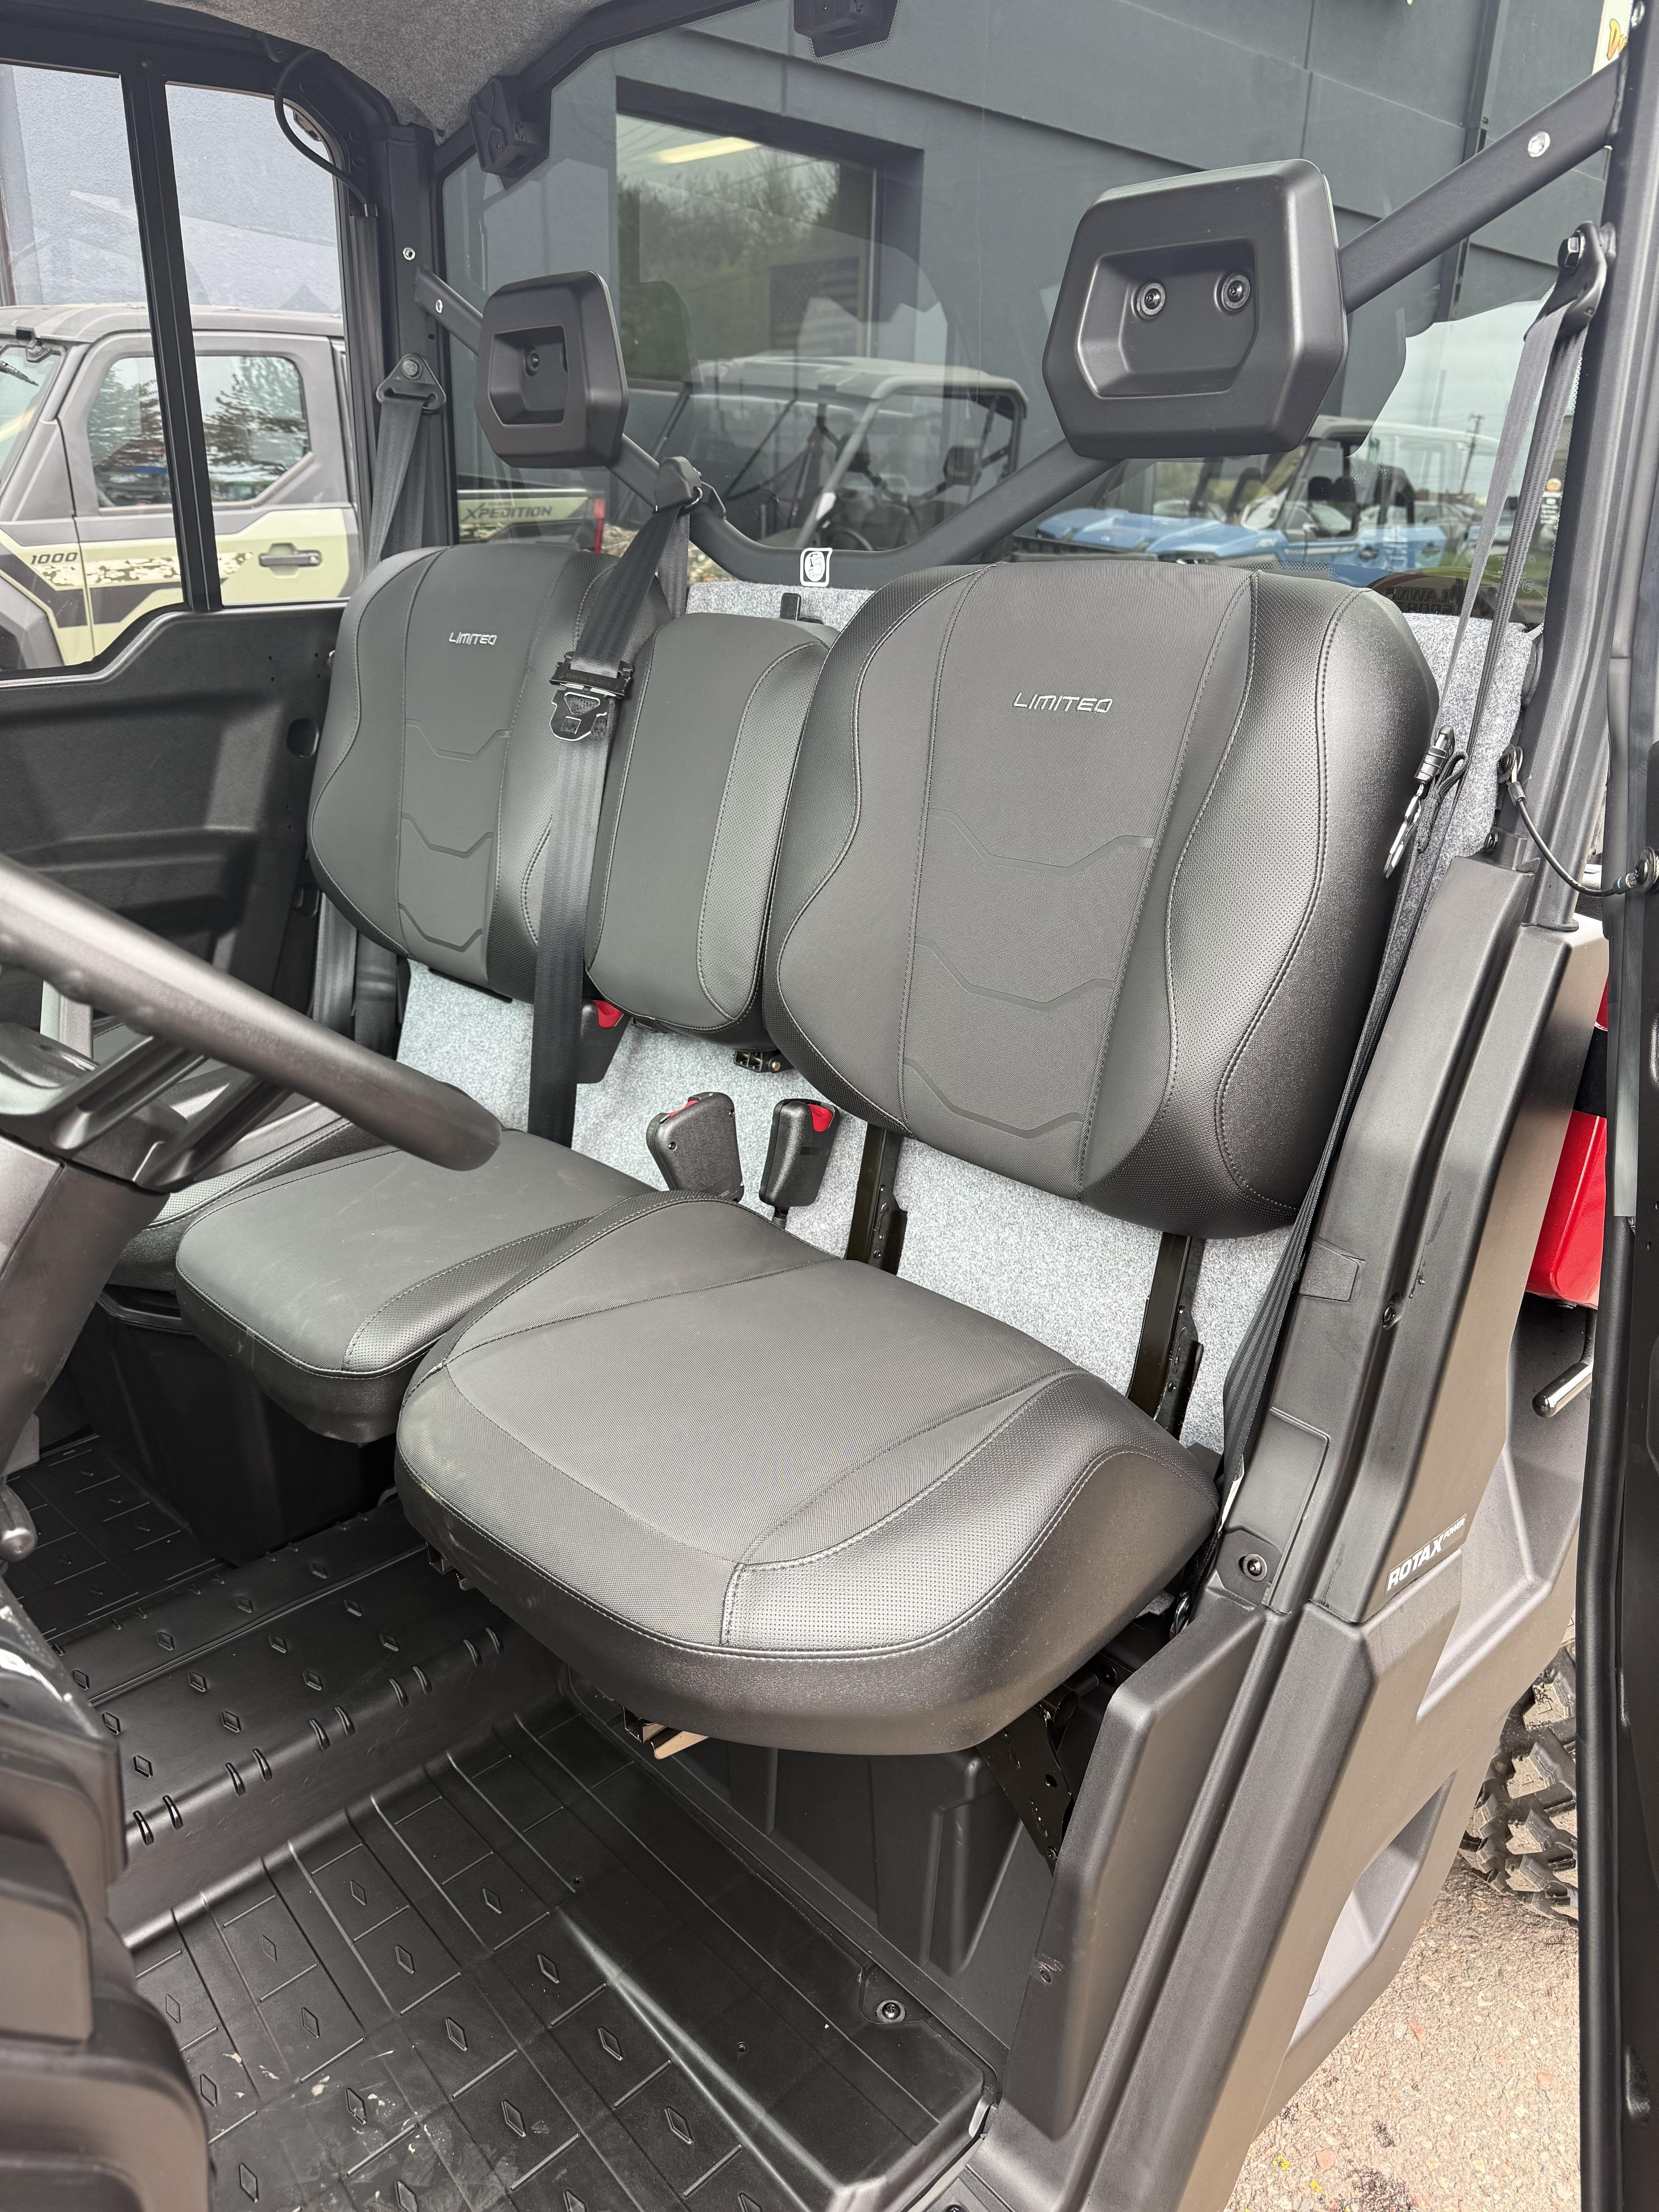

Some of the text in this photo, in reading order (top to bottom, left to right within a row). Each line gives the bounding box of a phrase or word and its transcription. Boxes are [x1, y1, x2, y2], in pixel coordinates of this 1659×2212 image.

[460, 503, 553, 522] XPEDITION
[31, 552, 77, 565] 1000
[449, 632, 497, 645] LIMITED
[1012, 692, 1113, 713] LIMITED
[1387, 1517, 1466, 1592] ROTAX POWER
